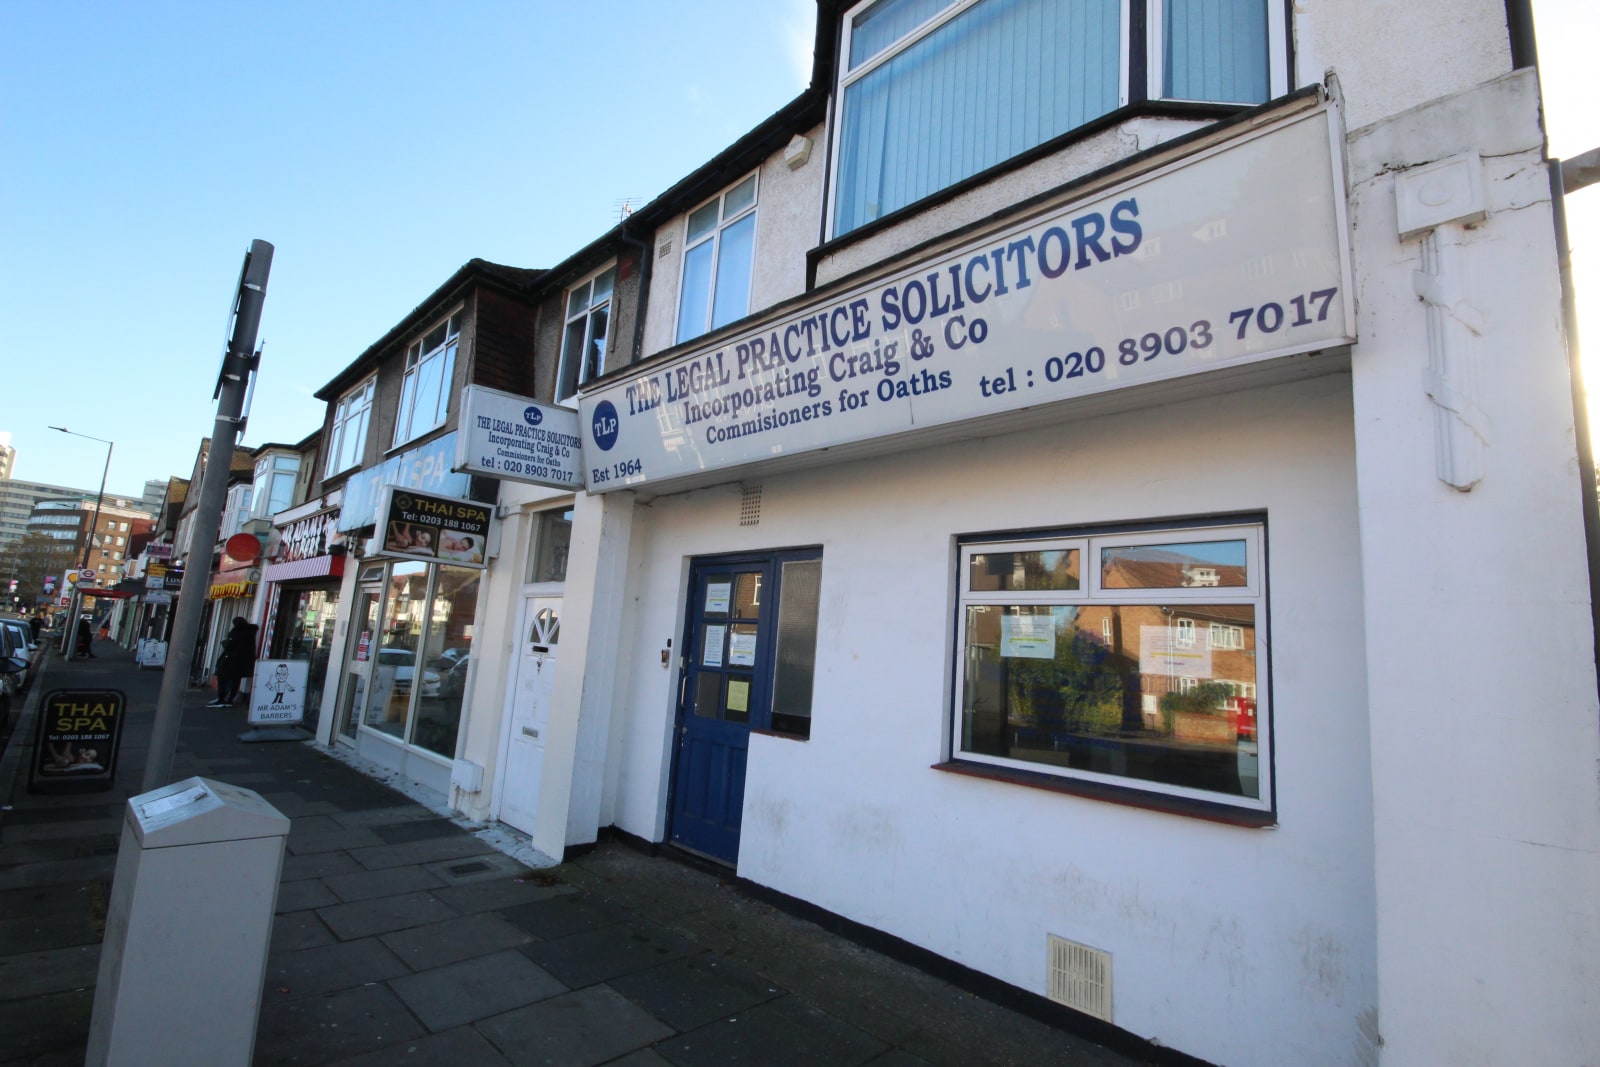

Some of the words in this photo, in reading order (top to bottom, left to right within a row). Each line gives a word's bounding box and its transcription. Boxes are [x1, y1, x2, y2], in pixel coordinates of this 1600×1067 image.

[626, 377, 662, 416] THE
[665, 352, 730, 403] LEGAL
[736, 298, 871, 380] PRACTICE
[881, 197, 1142, 332] SOLICITORS
[1045, 346, 1105, 382] 020
[1118, 320, 1213, 366] 8903
[1229, 287, 1338, 340] 7017
[684, 365, 822, 424] Incorporating
[828, 338, 901, 382] Craig
[910, 328, 934, 361] &
[944, 315, 988, 350] Co
[525, 410, 542, 421] TLP
[706, 400, 832, 444] Commisioners
[839, 388, 869, 413] for
[877, 368, 952, 401] Oaths
[477, 415, 491, 430] THE
[492, 418, 514, 436] LEGAL
[515, 423, 546, 442] PRACTICE
[546, 431, 582, 449] SOLICITORS
[594, 417, 617, 437] TLP
[488, 431, 535, 454] Incorporating
[536, 441, 554, 456] Craig
[561, 447, 570, 459] Co
[496, 447, 536, 464] Commisioners
[537, 454, 545, 465] for
[546, 457, 561, 468] Oaths
[503, 461, 522, 473] 020
[525, 465, 548, 478] 8903
[551, 470, 573, 482] 7017
[592, 468, 611, 483] Est
[613, 458, 643, 477] 1964
[415, 498, 453, 516] THAI
[456, 508, 486, 522] SPA
[402, 511, 418, 522] Tel:
[420, 514, 442, 526] 0203
[444, 519, 459, 529] 188
[461, 522, 481, 532] 1067
[54, 703, 116, 716] THAI
[260, 712, 292, 720] BARBERS
[56, 718, 107, 731] SPA
